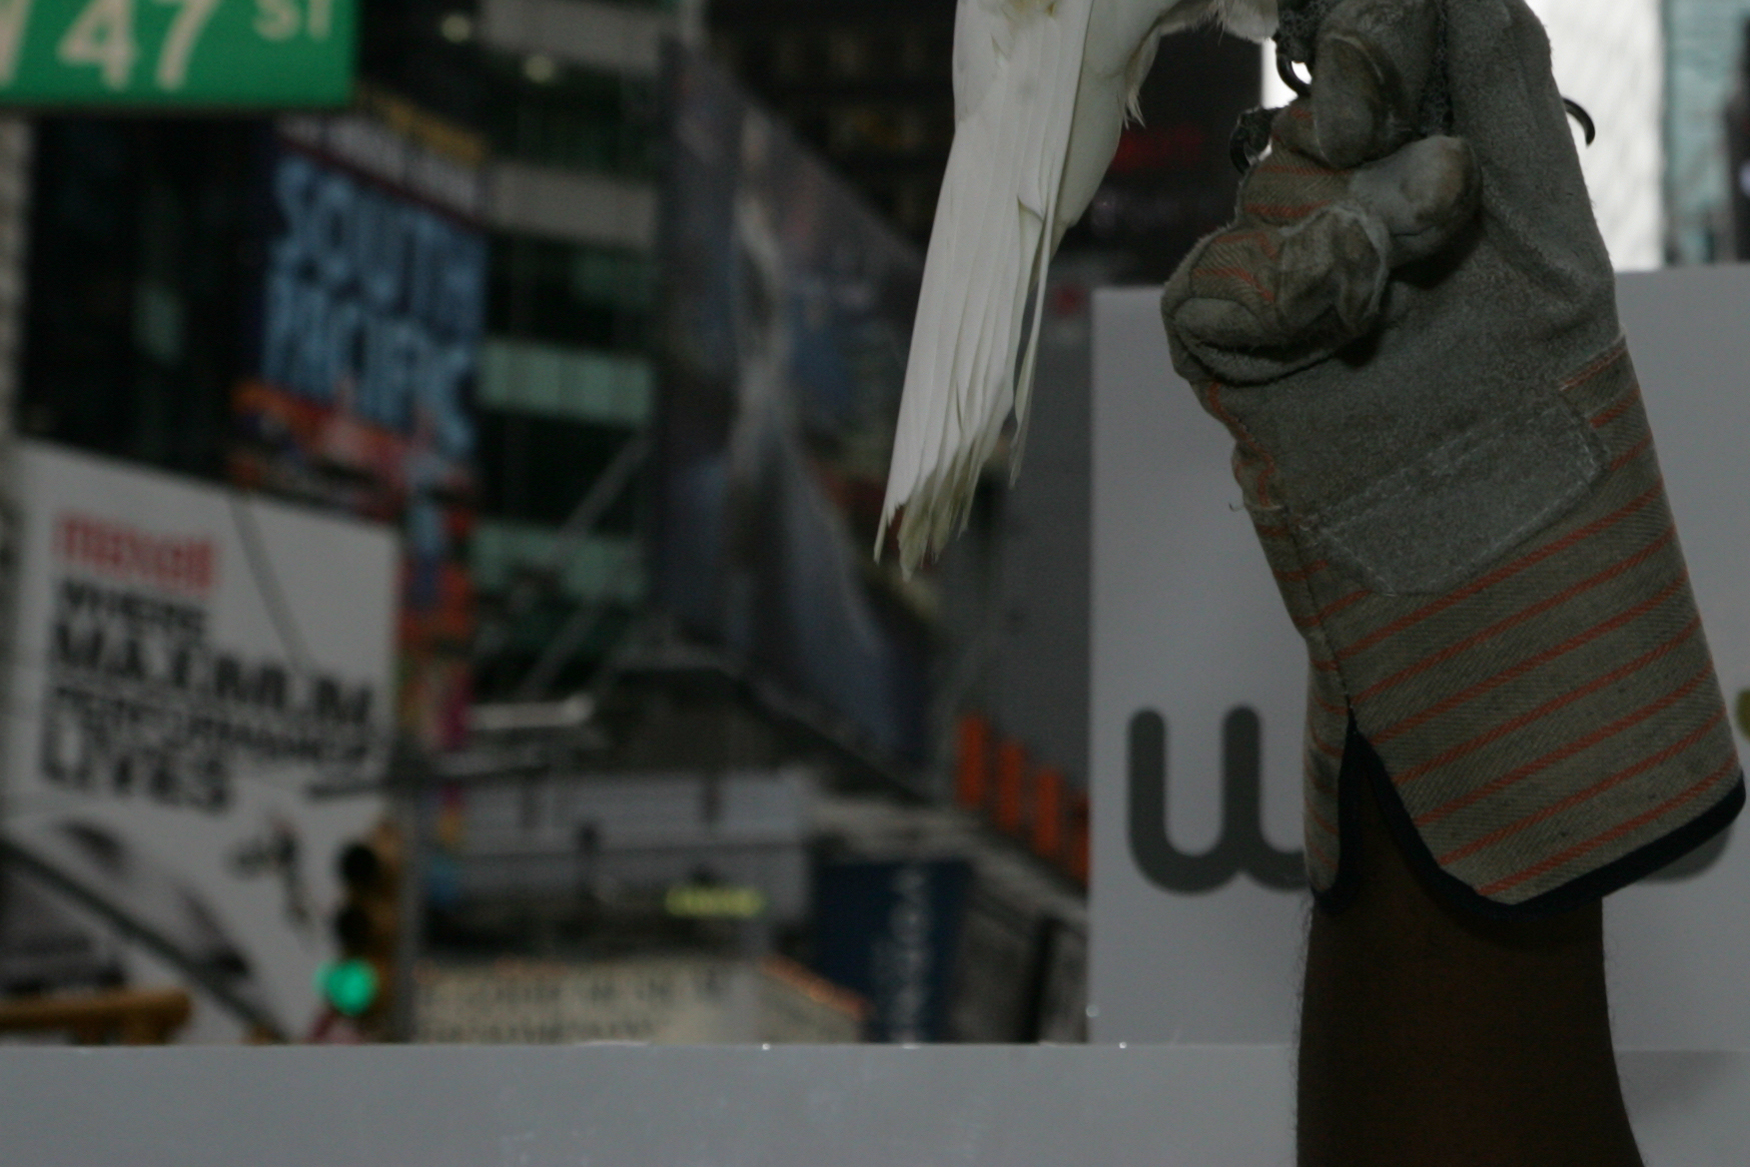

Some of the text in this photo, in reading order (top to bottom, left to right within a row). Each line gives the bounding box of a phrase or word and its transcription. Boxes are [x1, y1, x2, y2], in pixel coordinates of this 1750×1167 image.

[274, 154, 484, 340] SOUTH
[54, 512, 220, 597] maxell
[56, 575, 208, 638] WHERE
[50, 616, 378, 732] MAXIMUM
